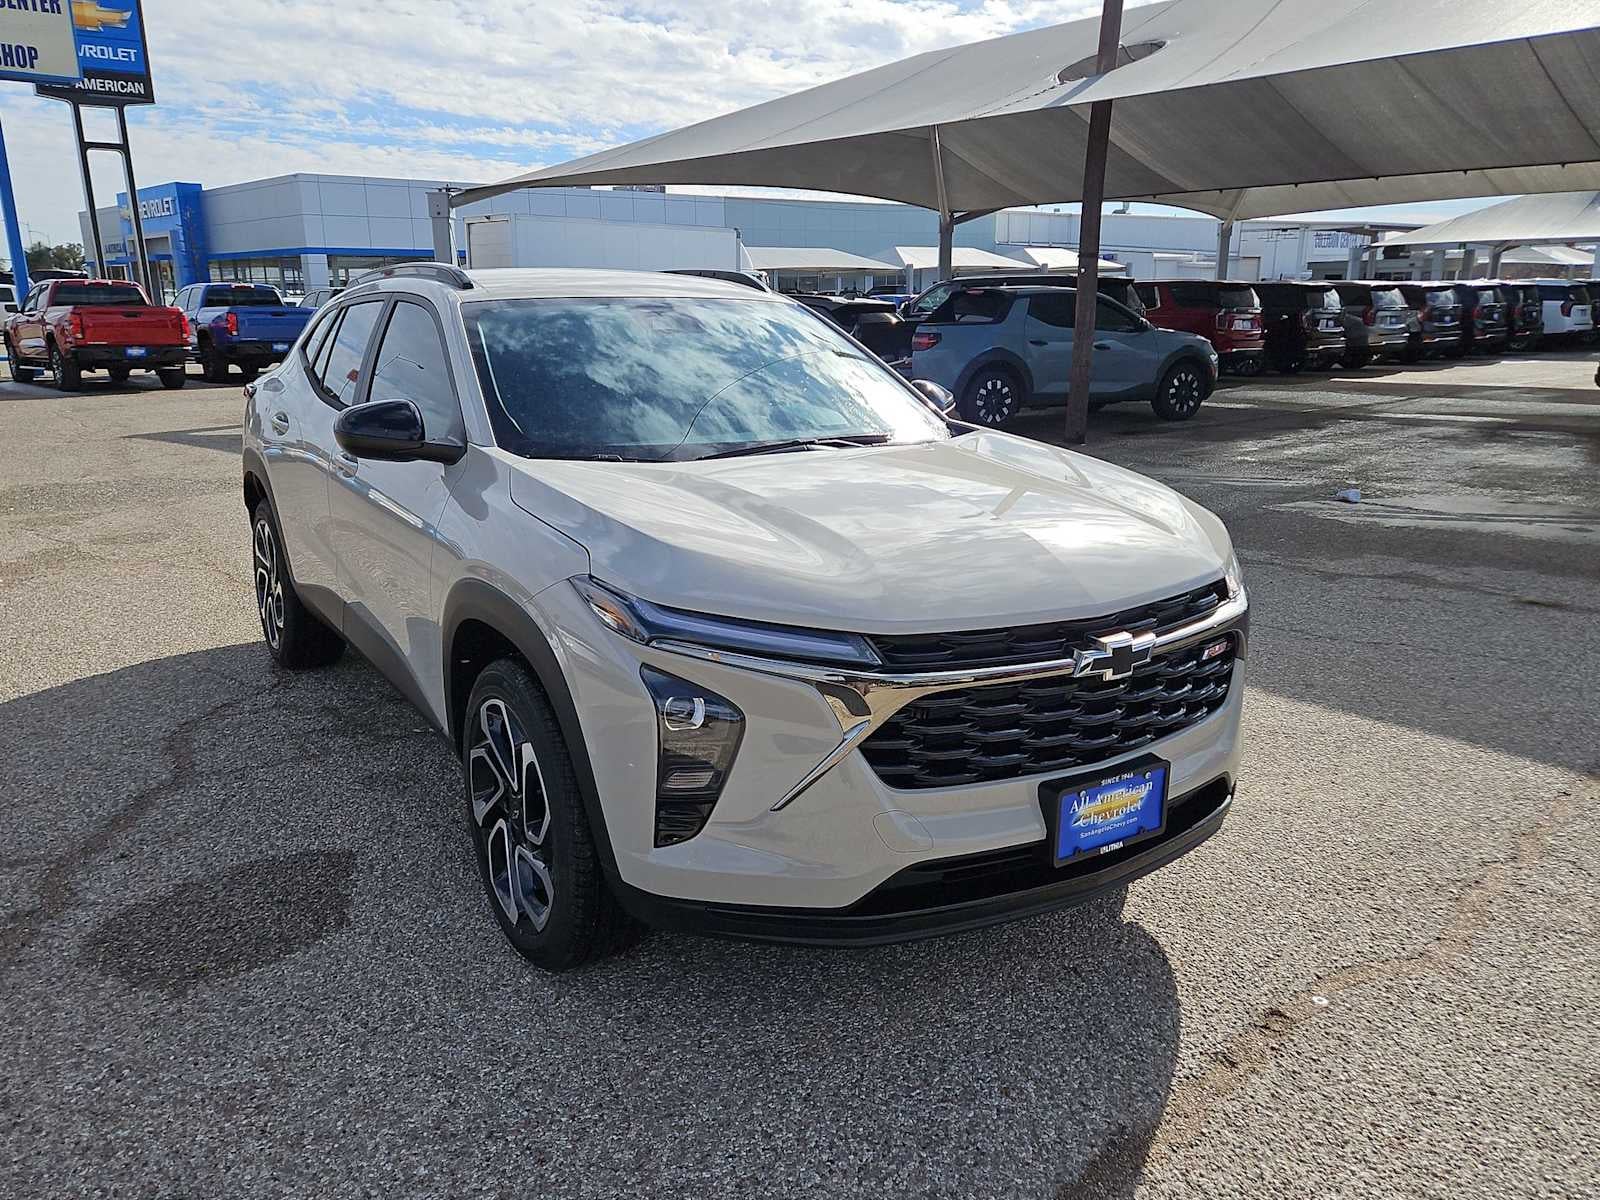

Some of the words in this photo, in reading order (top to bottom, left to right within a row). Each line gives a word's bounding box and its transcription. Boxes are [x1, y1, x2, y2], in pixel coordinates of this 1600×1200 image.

[0, 43, 39, 69] HOP
[75, 78, 145, 95] AMERICAN
[140, 197, 174, 219] EVROLET
[1101, 775, 1120, 786] SINCE
[1069, 794, 1090, 814] All
[1094, 781, 1153, 805] American
[1080, 800, 1142, 827] Chevrolet
